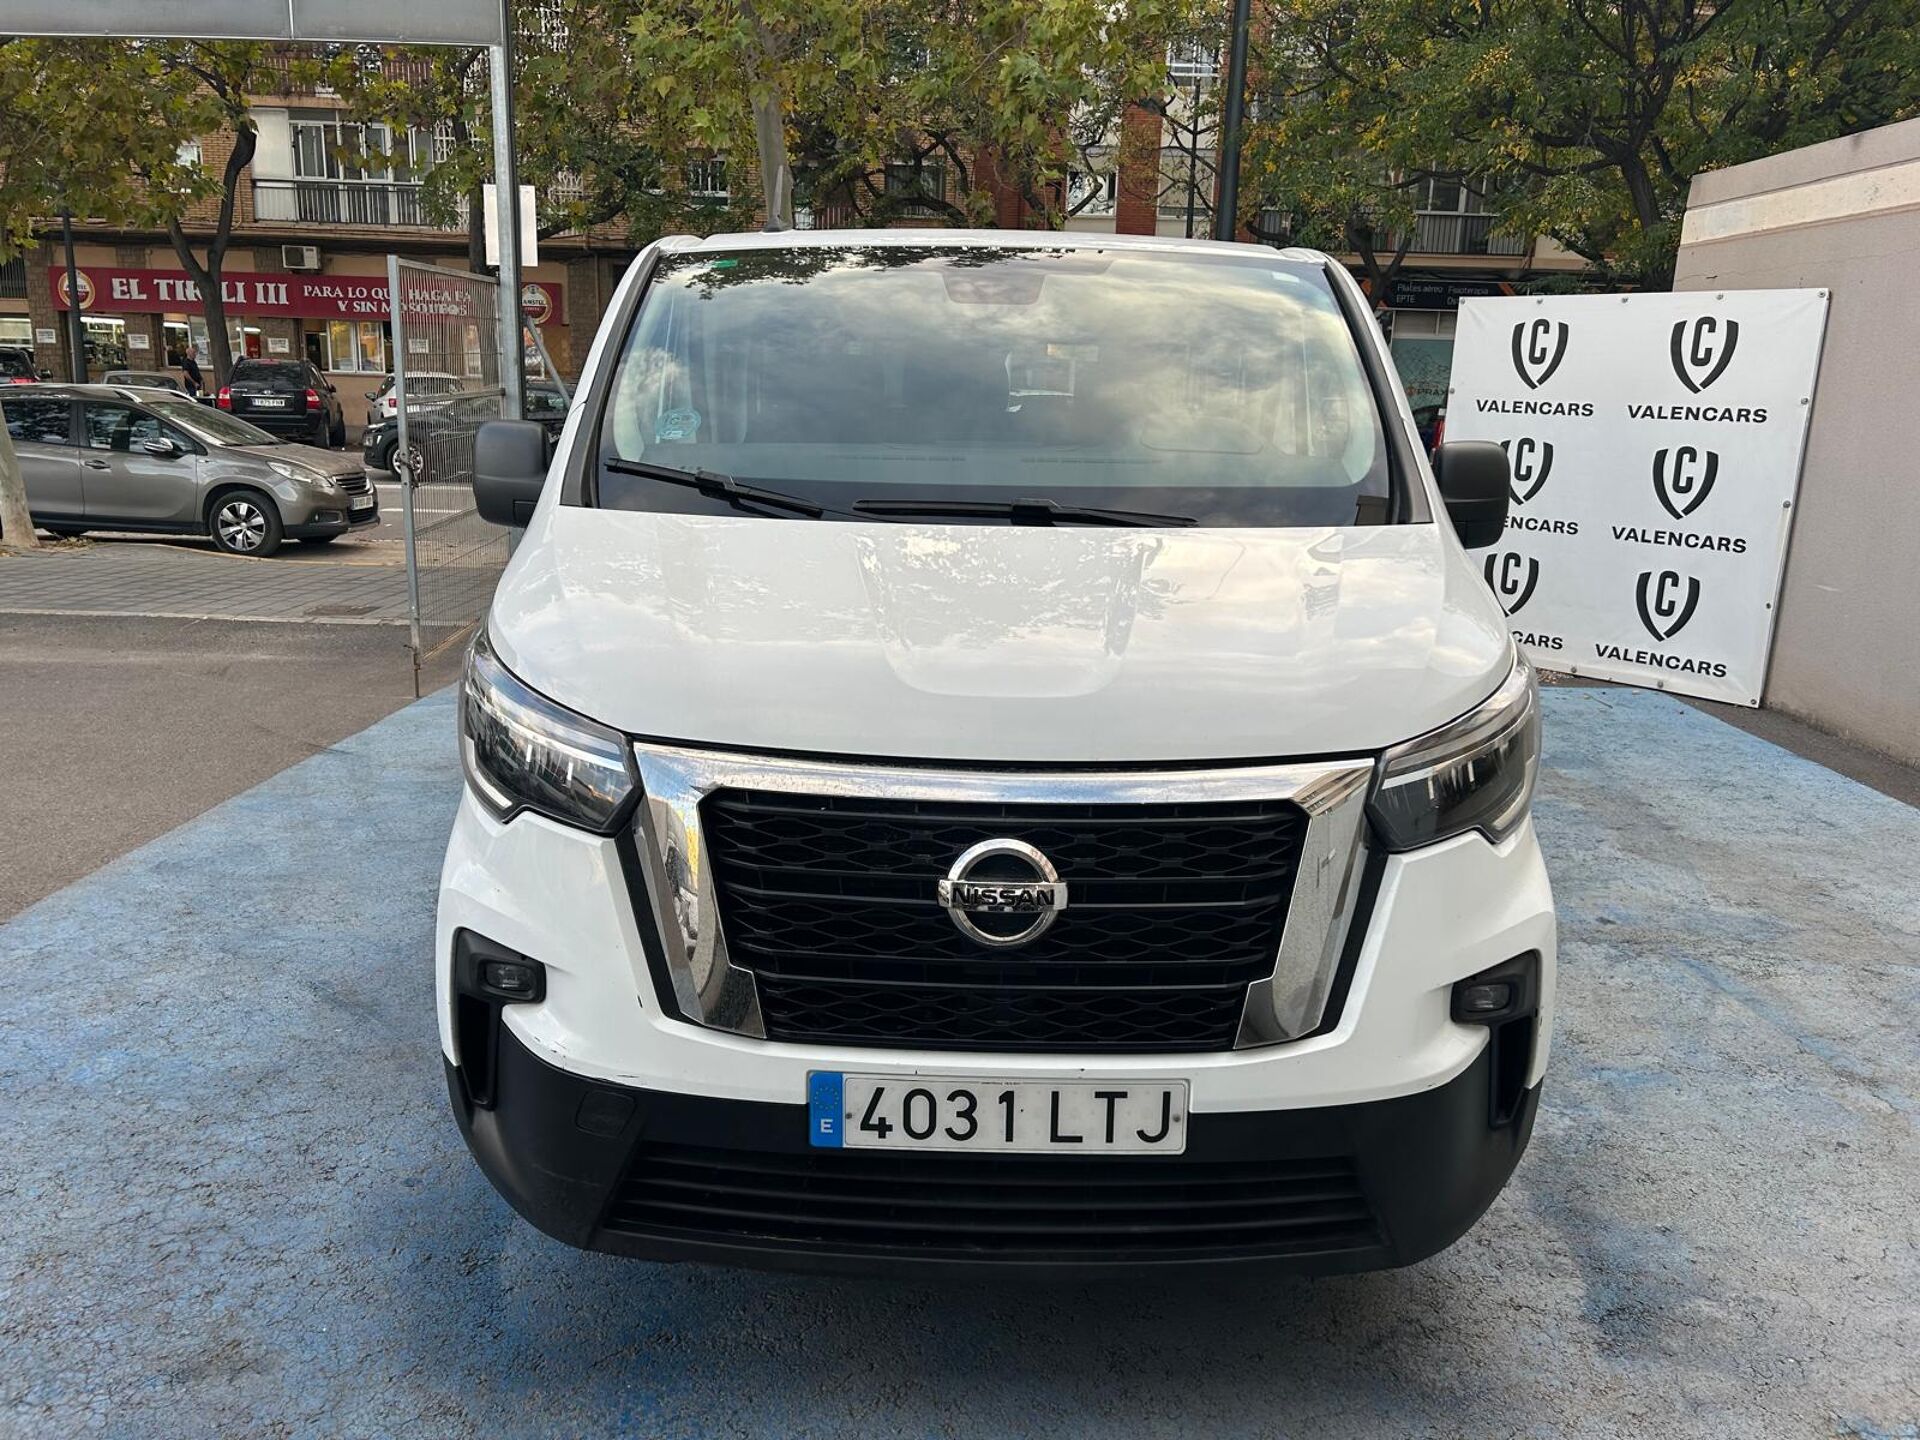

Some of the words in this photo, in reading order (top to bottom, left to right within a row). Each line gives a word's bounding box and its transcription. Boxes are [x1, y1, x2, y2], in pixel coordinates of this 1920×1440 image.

[112, 278, 147, 300] EL
[153, 279, 247, 303] TIRLI
[254, 282, 289, 305] III
[303, 285, 343, 298] PARA
[348, 287, 367, 299] LO
[337, 300, 348, 312] Y
[353, 300, 377, 313] SIN
[1476, 399, 1594, 417] VALENCARS
[1627, 404, 1768, 423] VALENCARS
[1611, 526, 1747, 554] VALENCARS
[1595, 644, 1727, 678] VALENCARS
[952, 887, 1054, 906] NISSAN
[859, 1086, 1014, 1142] 4031
[1049, 1090, 1171, 1144] LTJ
[820, 1118, 833, 1133] E
